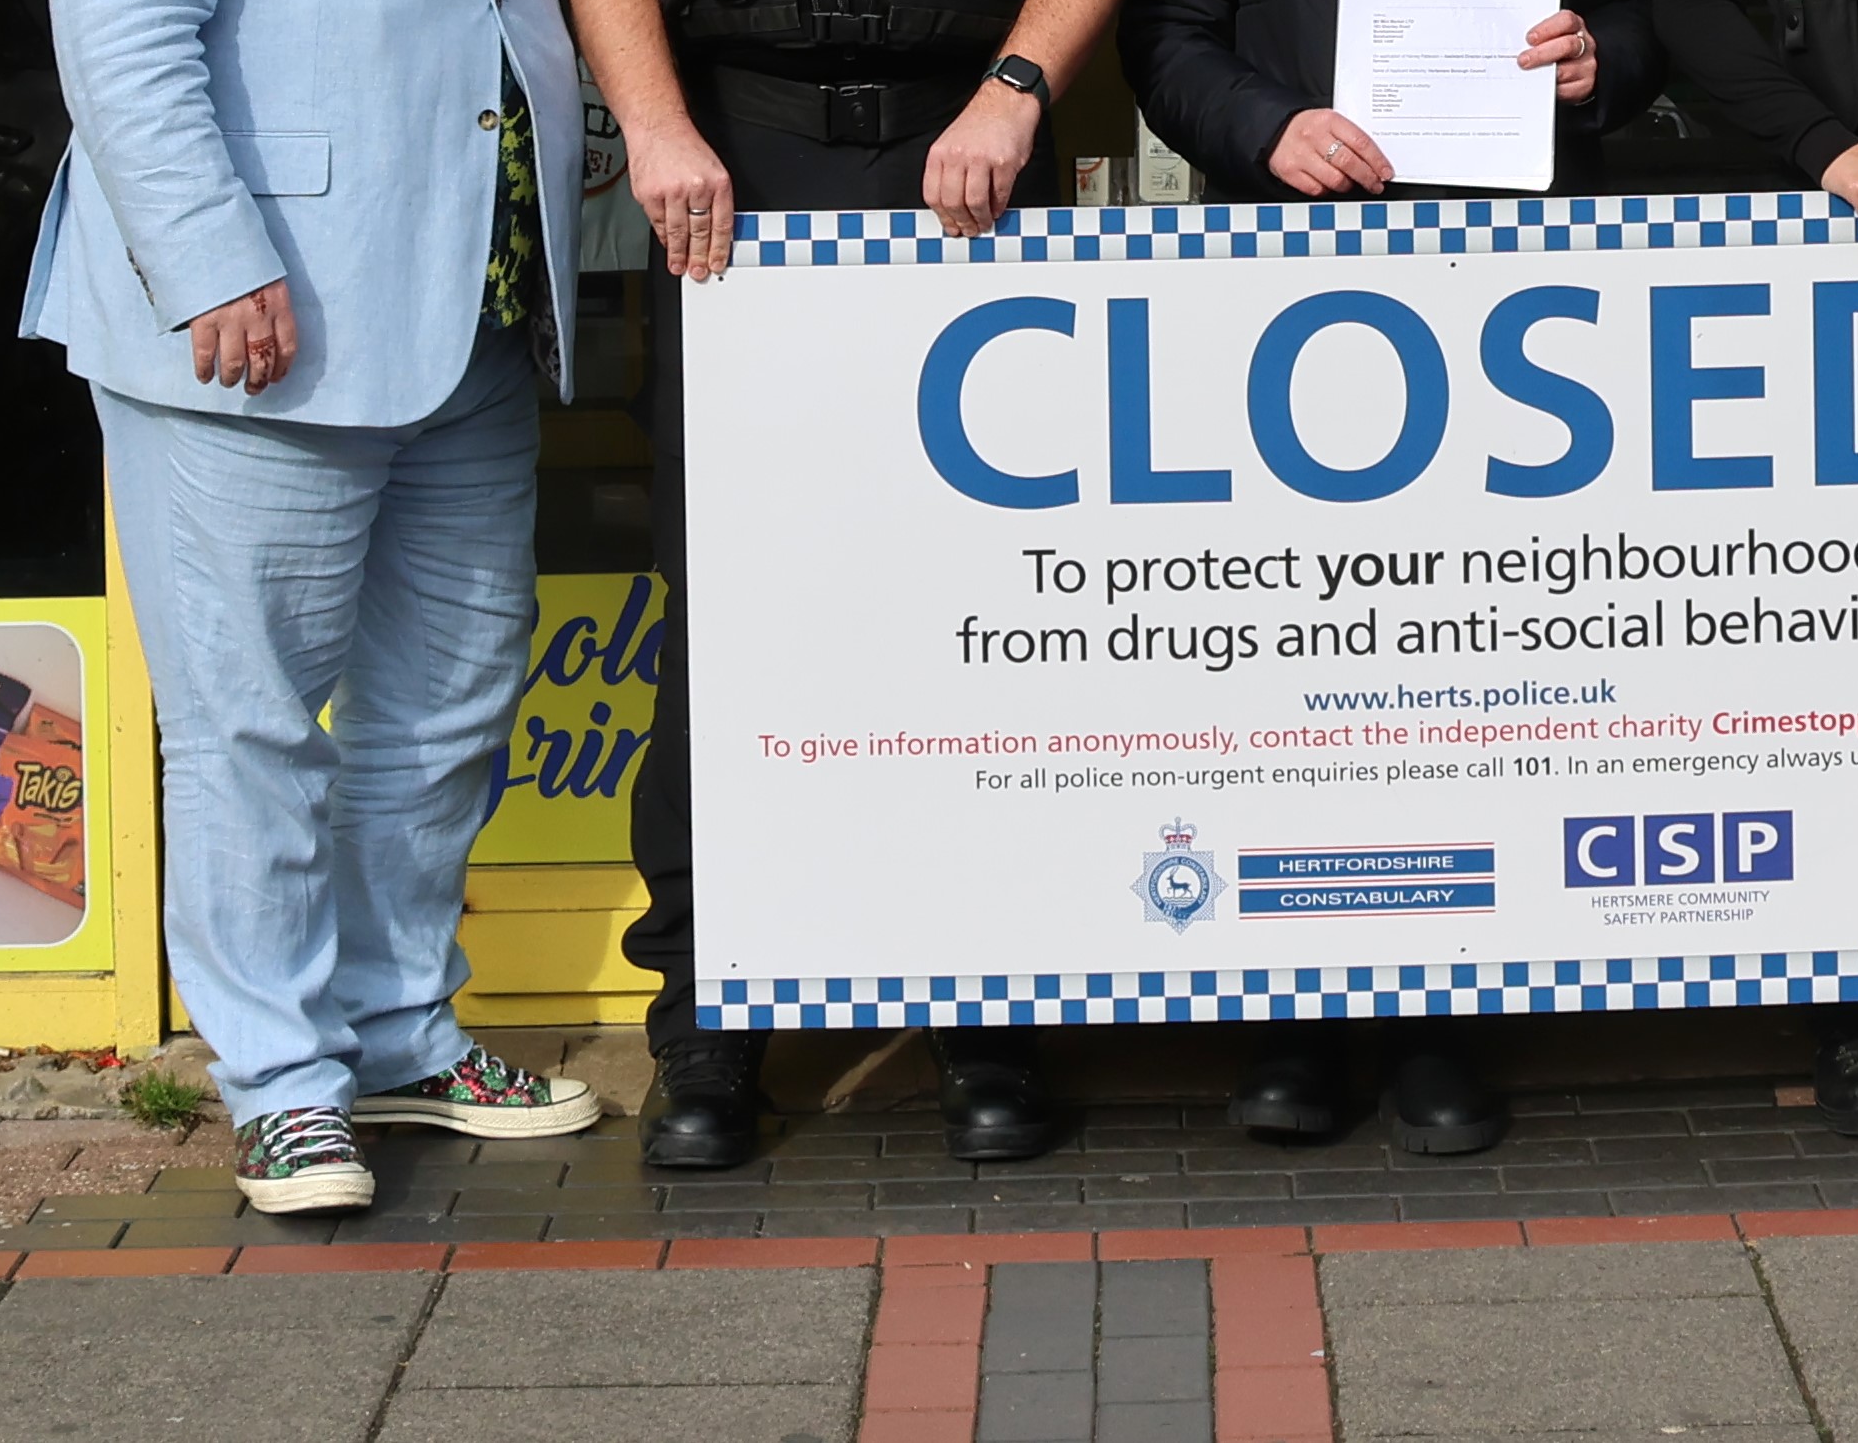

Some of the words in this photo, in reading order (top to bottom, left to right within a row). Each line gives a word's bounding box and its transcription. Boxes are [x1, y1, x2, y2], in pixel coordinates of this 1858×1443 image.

[1022, 548, 1088, 594] To
[1106, 547, 1302, 605] protect
[1317, 550, 1445, 600] your
[956, 615, 1089, 664] from
[1107, 613, 1259, 672] drugs
[1277, 607, 1378, 658] and
[1396, 600, 1664, 655] anti-social
[1303, 678, 1617, 713] www.herts.police.uk
[758, 734, 791, 758] To
[800, 733, 859, 764] give
[869, 730, 1038, 757] information
[1048, 725, 1239, 758] anonymously,
[1249, 725, 1354, 750] contact
[1363, 721, 1409, 746] the
[1418, 715, 1599, 750] independent
[1608, 713, 1703, 743] charity
[17, 762, 83, 810] Takis
[975, 769, 1013, 790] For
[1019, 768, 1047, 789] all
[1055, 766, 1124, 795] police
[1131, 764, 1264, 793] non-urgent
[1271, 761, 1379, 790] enquiries
[1386, 759, 1459, 788] please
[1466, 757, 1504, 778] call
[1513, 756, 1560, 777] 101.
[1567, 755, 1589, 775] In
[1596, 757, 1625, 774] an
[1632, 752, 1759, 777] emergency
[1766, 747, 1843, 773] always
[1278, 854, 1455, 873] HERTFORDSHIRE
[1577, 822, 1779, 879] CSP
[1279, 888, 1455, 908] CONSTABULARY
[1591, 893, 1673, 910] HERTSMERE
[1678, 890, 1770, 907] COMMUNITY
[1603, 910, 1655, 926] SAFETY
[1660, 908, 1754, 925] PARTNERSHIP
